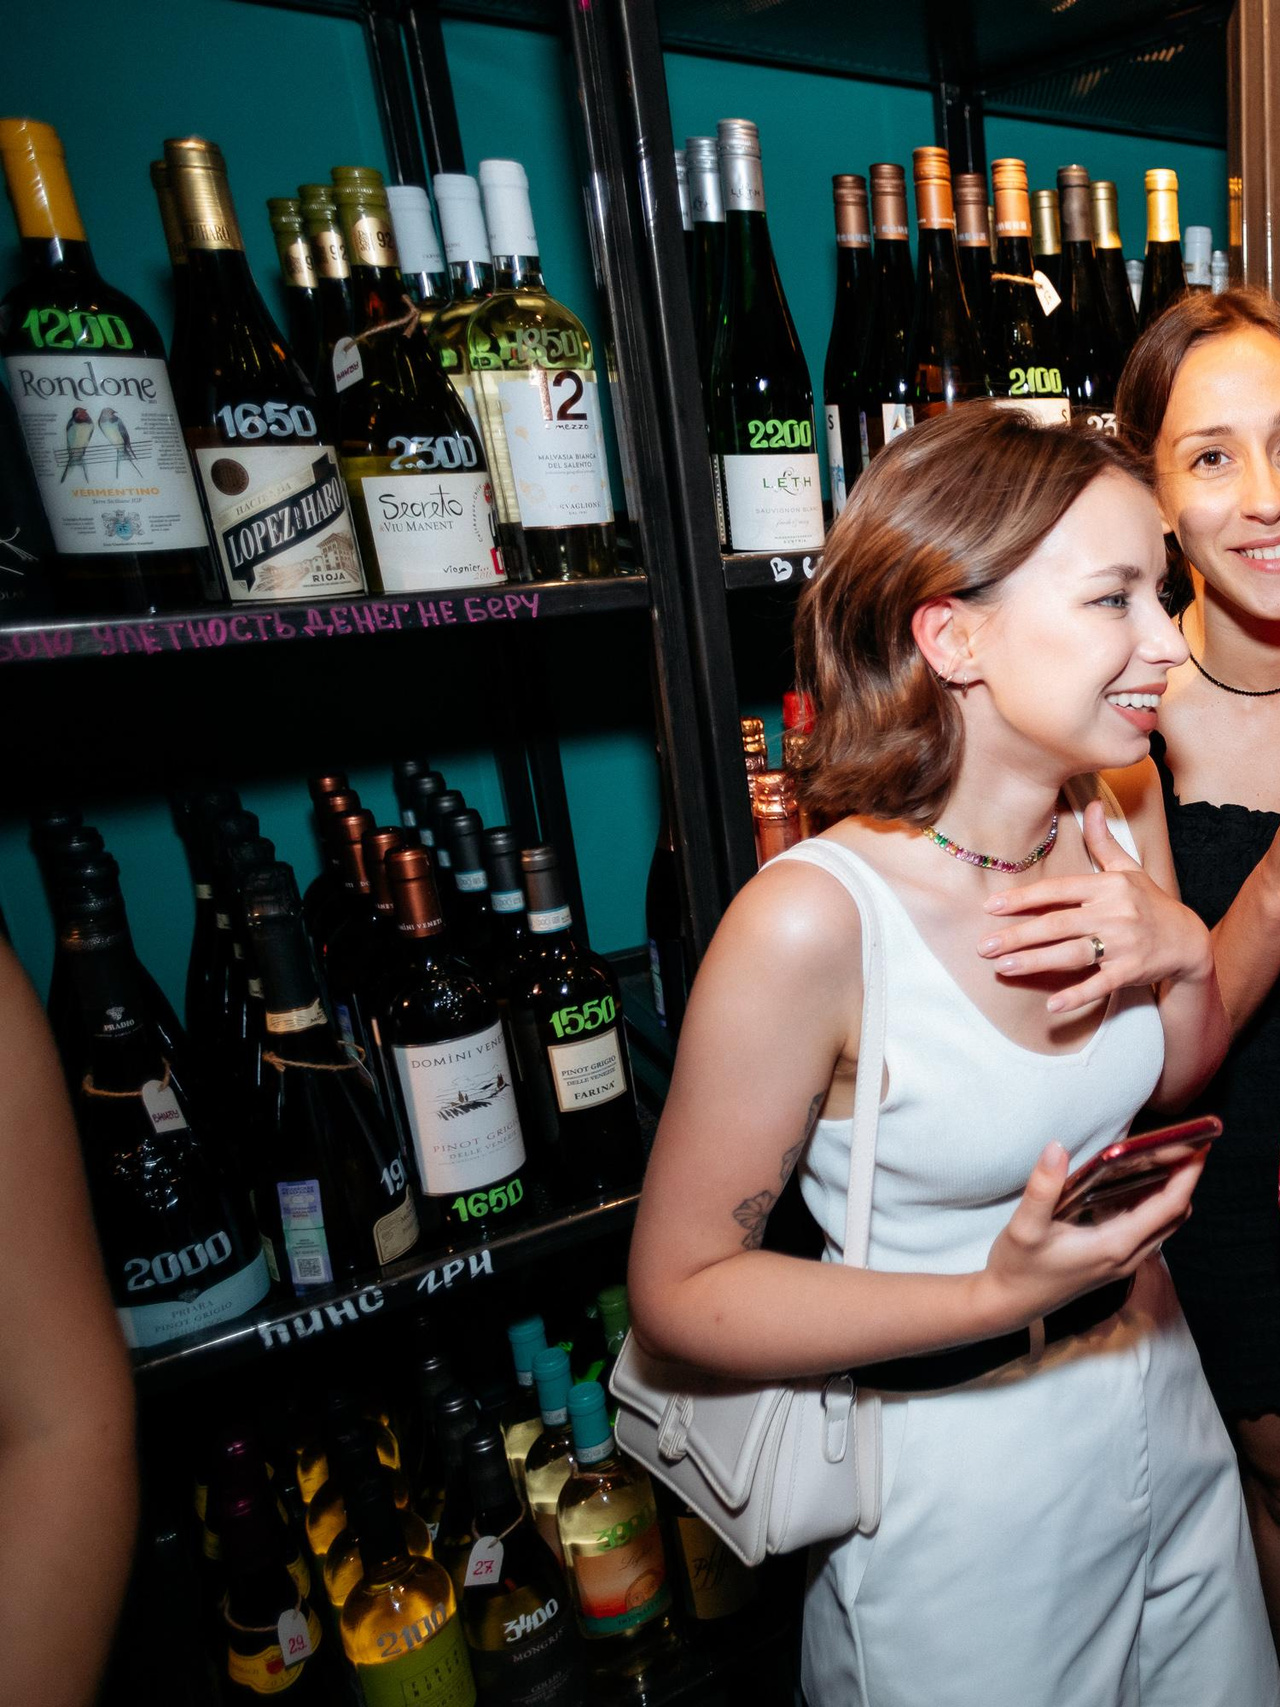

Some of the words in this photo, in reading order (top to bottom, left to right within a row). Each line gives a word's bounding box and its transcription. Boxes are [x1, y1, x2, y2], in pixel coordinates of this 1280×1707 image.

[22, 308, 133, 349] 1200
[516, 327, 578, 361] 1850
[19, 361, 157, 401] Rondone
[538, 371, 587, 421] 12
[1009, 367, 1062, 395] 2100
[216, 401, 318, 439] 1650
[556, 423, 589, 431] mezzo
[748, 420, 812, 449] 2200
[387, 436, 478, 470] 2300
[575, 452, 597, 460] BIANCA
[72, 487, 160, 498] VERMENTINO
[379, 485, 463, 520] Secreto
[228, 506, 296, 568] LOPEZ
[300, 477, 342, 530] HARO
[383, 521, 403, 533] VIU
[406, 520, 454, 532] MANENT
[312, 572, 345, 583] RIOJA
[303, 602, 409, 637] ДЕНЕГ
[417, 600, 457, 627] НЕ
[104, 1019, 135, 1031] PRADIO
[550, 995, 616, 1038] 1550
[561, 1065, 588, 1077] PINOT
[590, 1055, 616, 1070] GRIGIO
[566, 1078, 589, 1086] DELLE
[433, 1138, 479, 1153] PINOT
[452, 1178, 524, 1222] 1650
[123, 1231, 232, 1292] 2000
[154, 1319, 188, 1333] PINOT
[194, 1300, 233, 1322] GRIGIO
[473, 1560, 494, 1577] 27
[503, 1598, 559, 1643] 3400
[288, 1634, 306, 1655] 29
